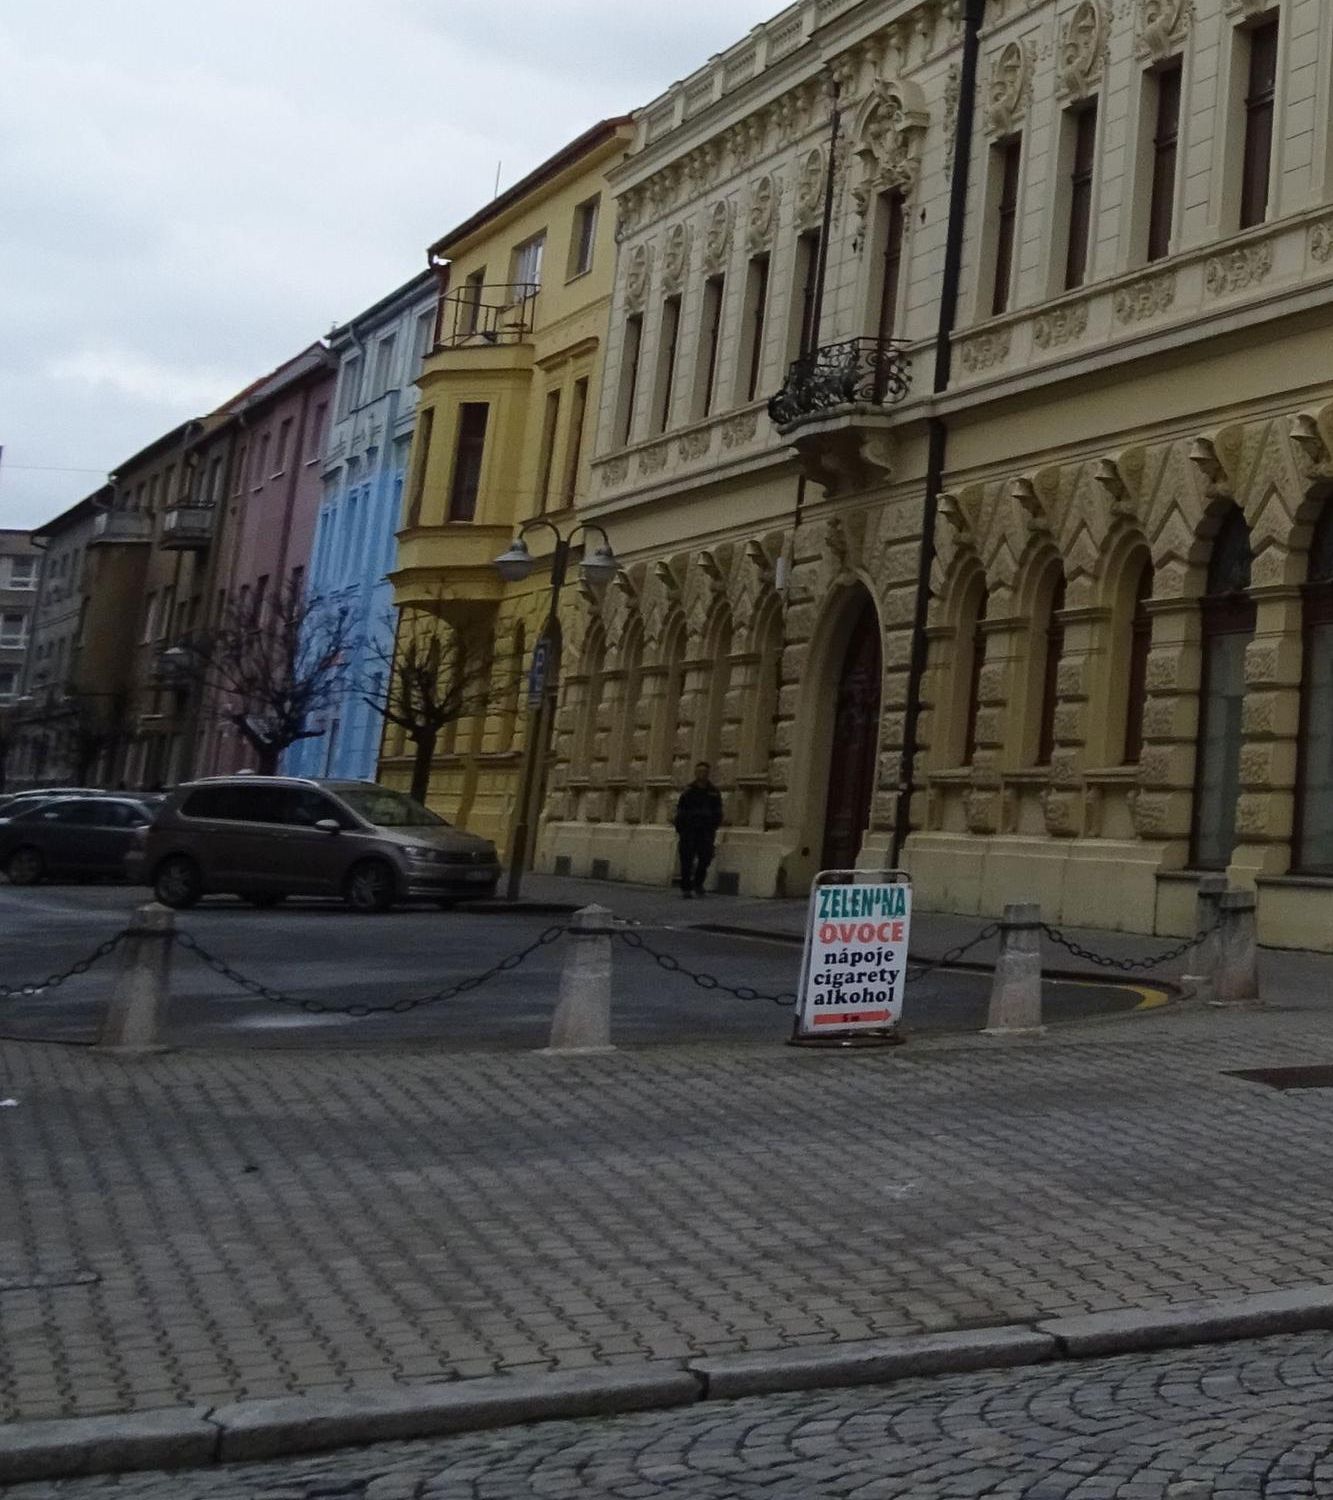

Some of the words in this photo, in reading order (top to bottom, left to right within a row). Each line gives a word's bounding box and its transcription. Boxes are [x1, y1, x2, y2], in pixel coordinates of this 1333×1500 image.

[819, 922, 904, 944] OVOCE
[824, 947, 894, 967] nápoje
[814, 968, 900, 988] cigarety
[814, 987, 894, 1005] alkohol
